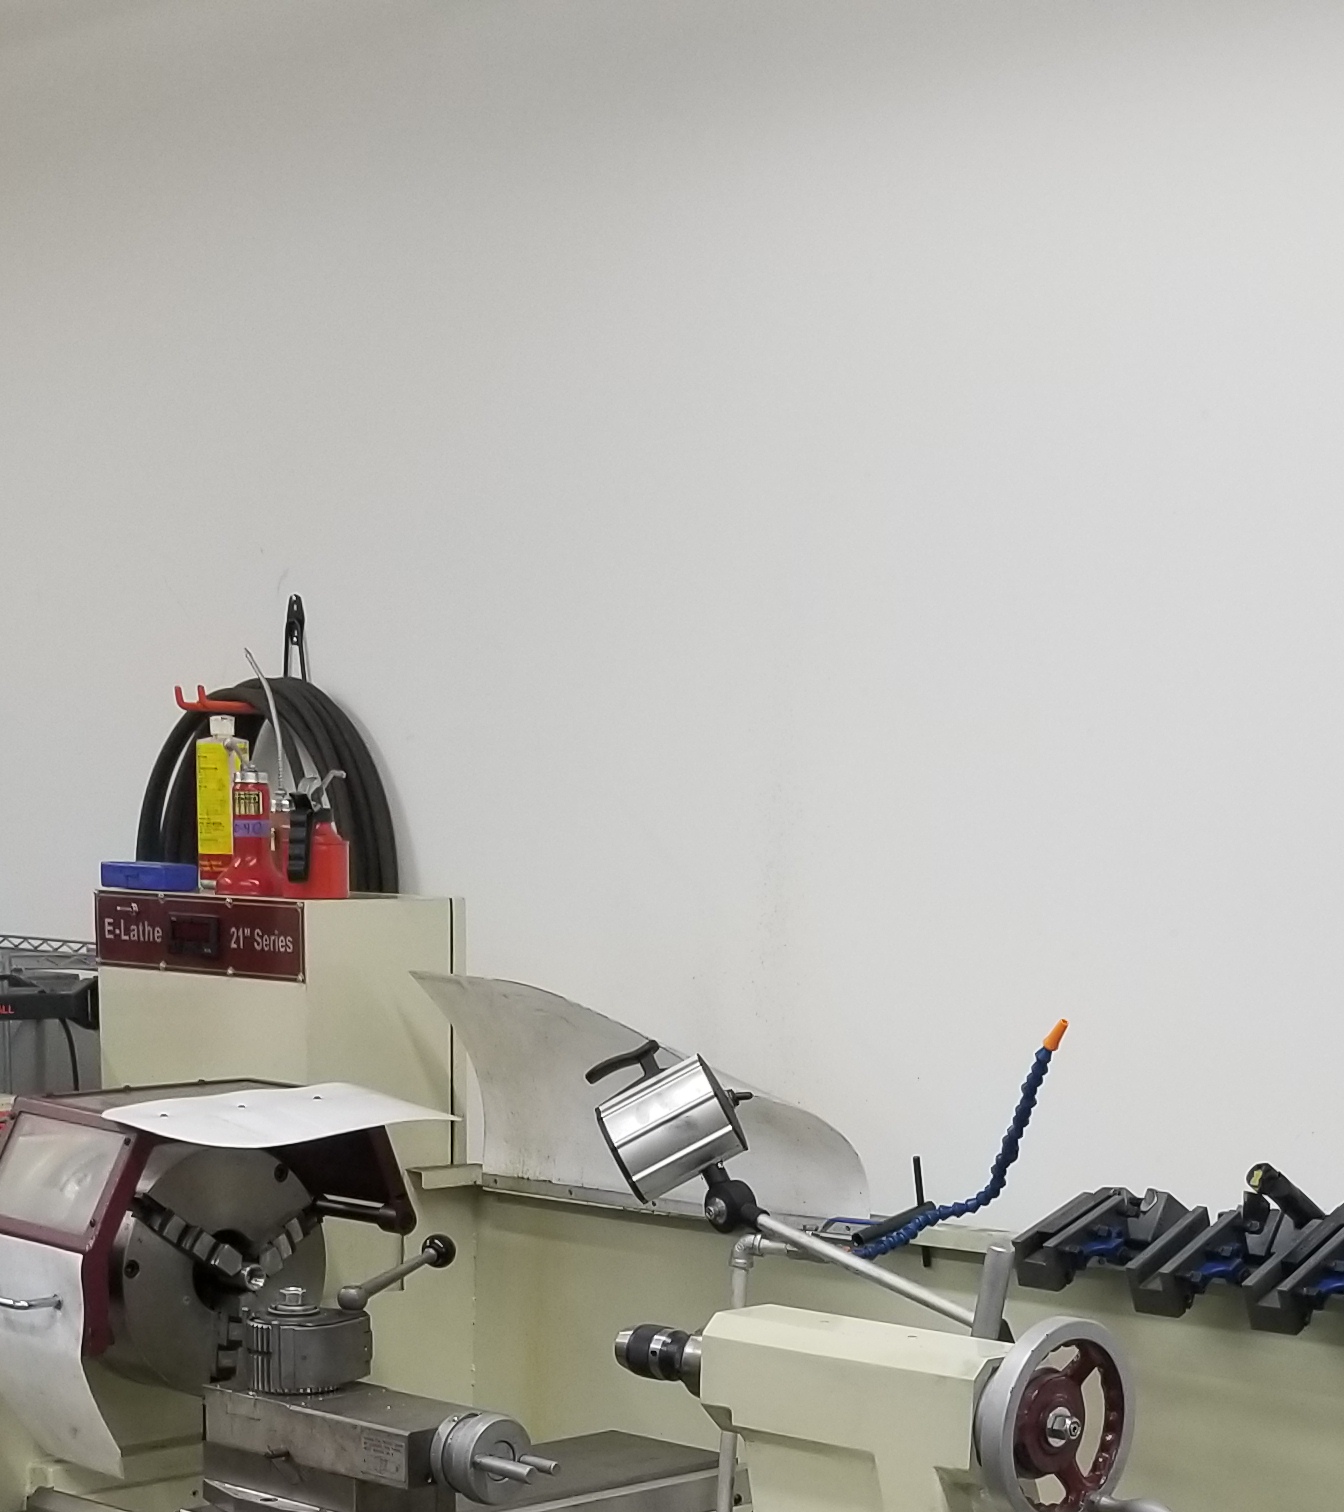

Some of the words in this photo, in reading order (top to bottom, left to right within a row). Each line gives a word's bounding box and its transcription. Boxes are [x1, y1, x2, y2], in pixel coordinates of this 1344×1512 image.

[104, 918, 163, 943] E-Lathe
[229, 927, 250, 950] 21"
[254, 928, 293, 953] Series
